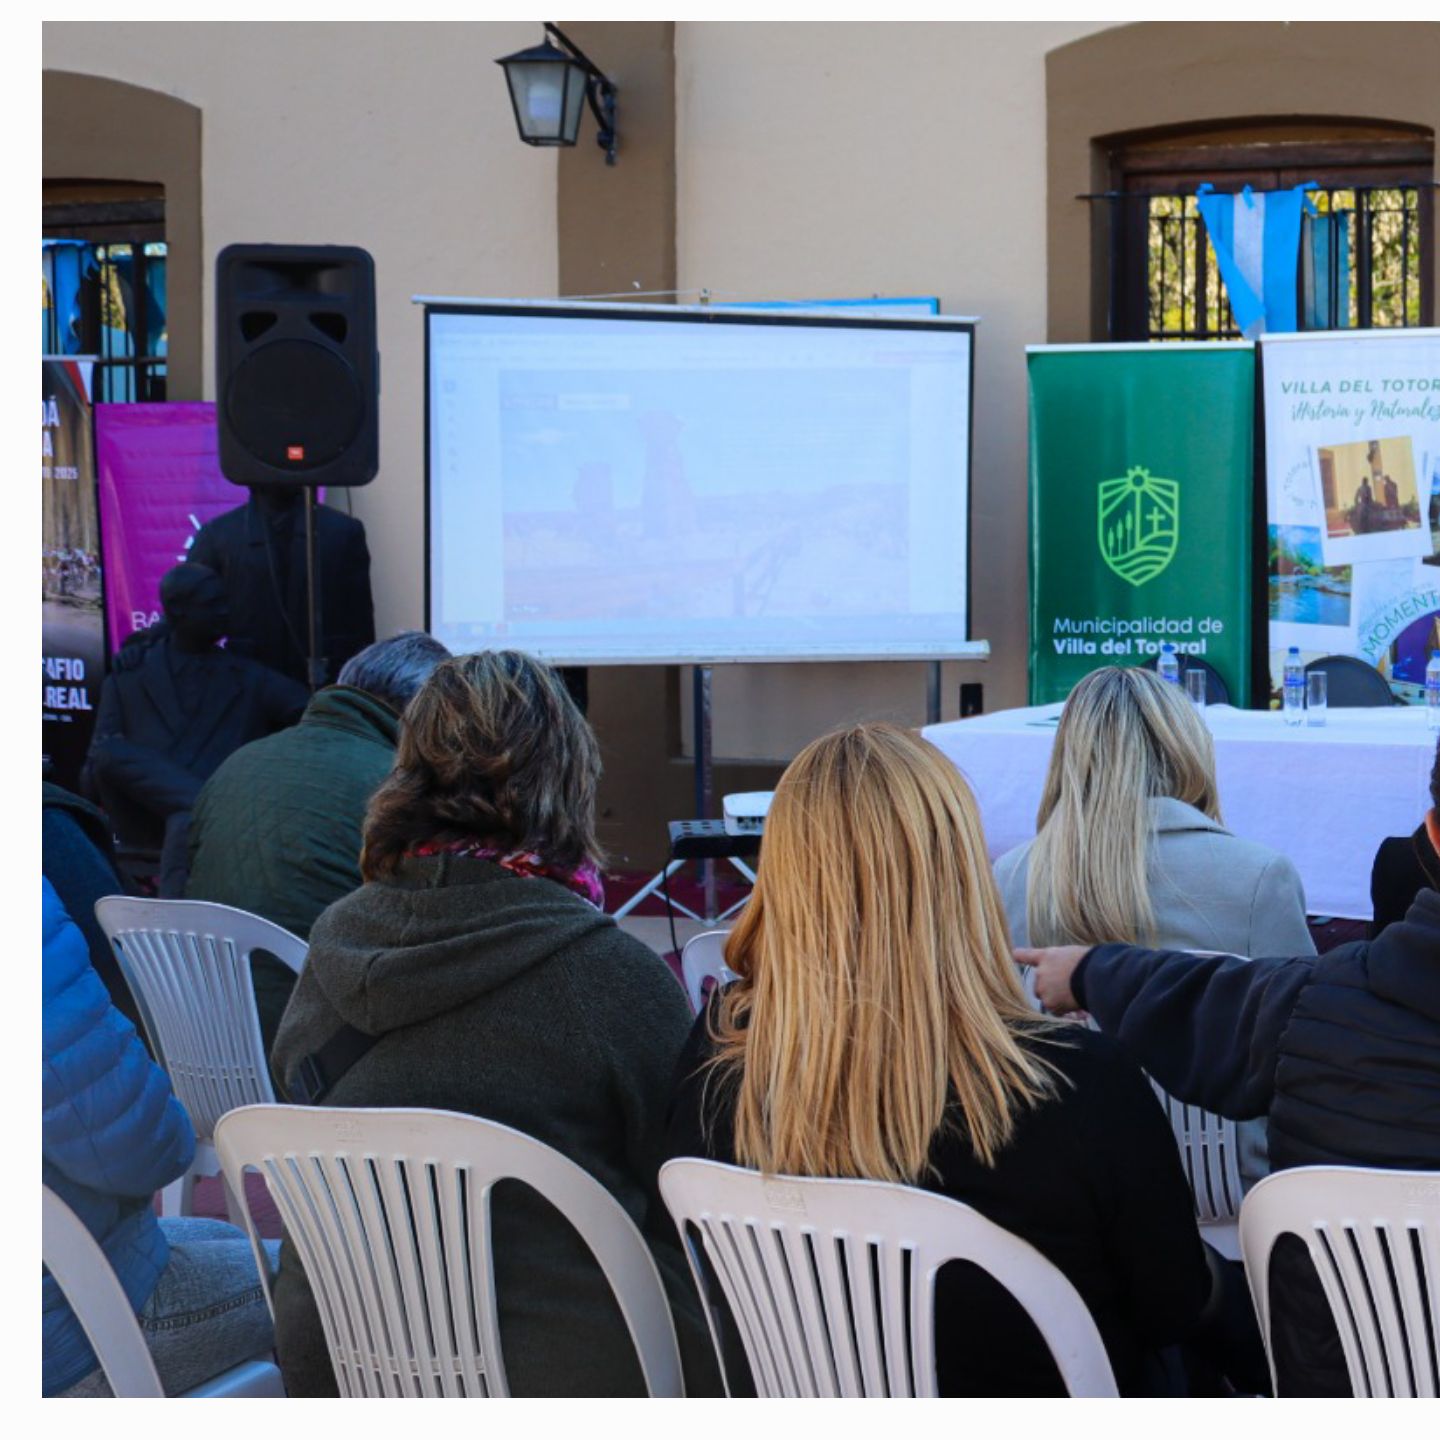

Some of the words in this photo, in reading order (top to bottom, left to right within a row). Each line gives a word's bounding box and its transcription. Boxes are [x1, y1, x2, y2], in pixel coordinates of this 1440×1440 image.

[1281, 381, 1332, 395] VILLA
[1339, 380, 1373, 394] DEL
[1353, 406, 1365, 427] y
[1053, 616, 1193, 637] Municipalidad
[1198, 616, 1224, 635] de
[1053, 638, 1097, 655] Villa
[1100, 638, 1132, 655] del
[43, 685, 93, 711] REAL
